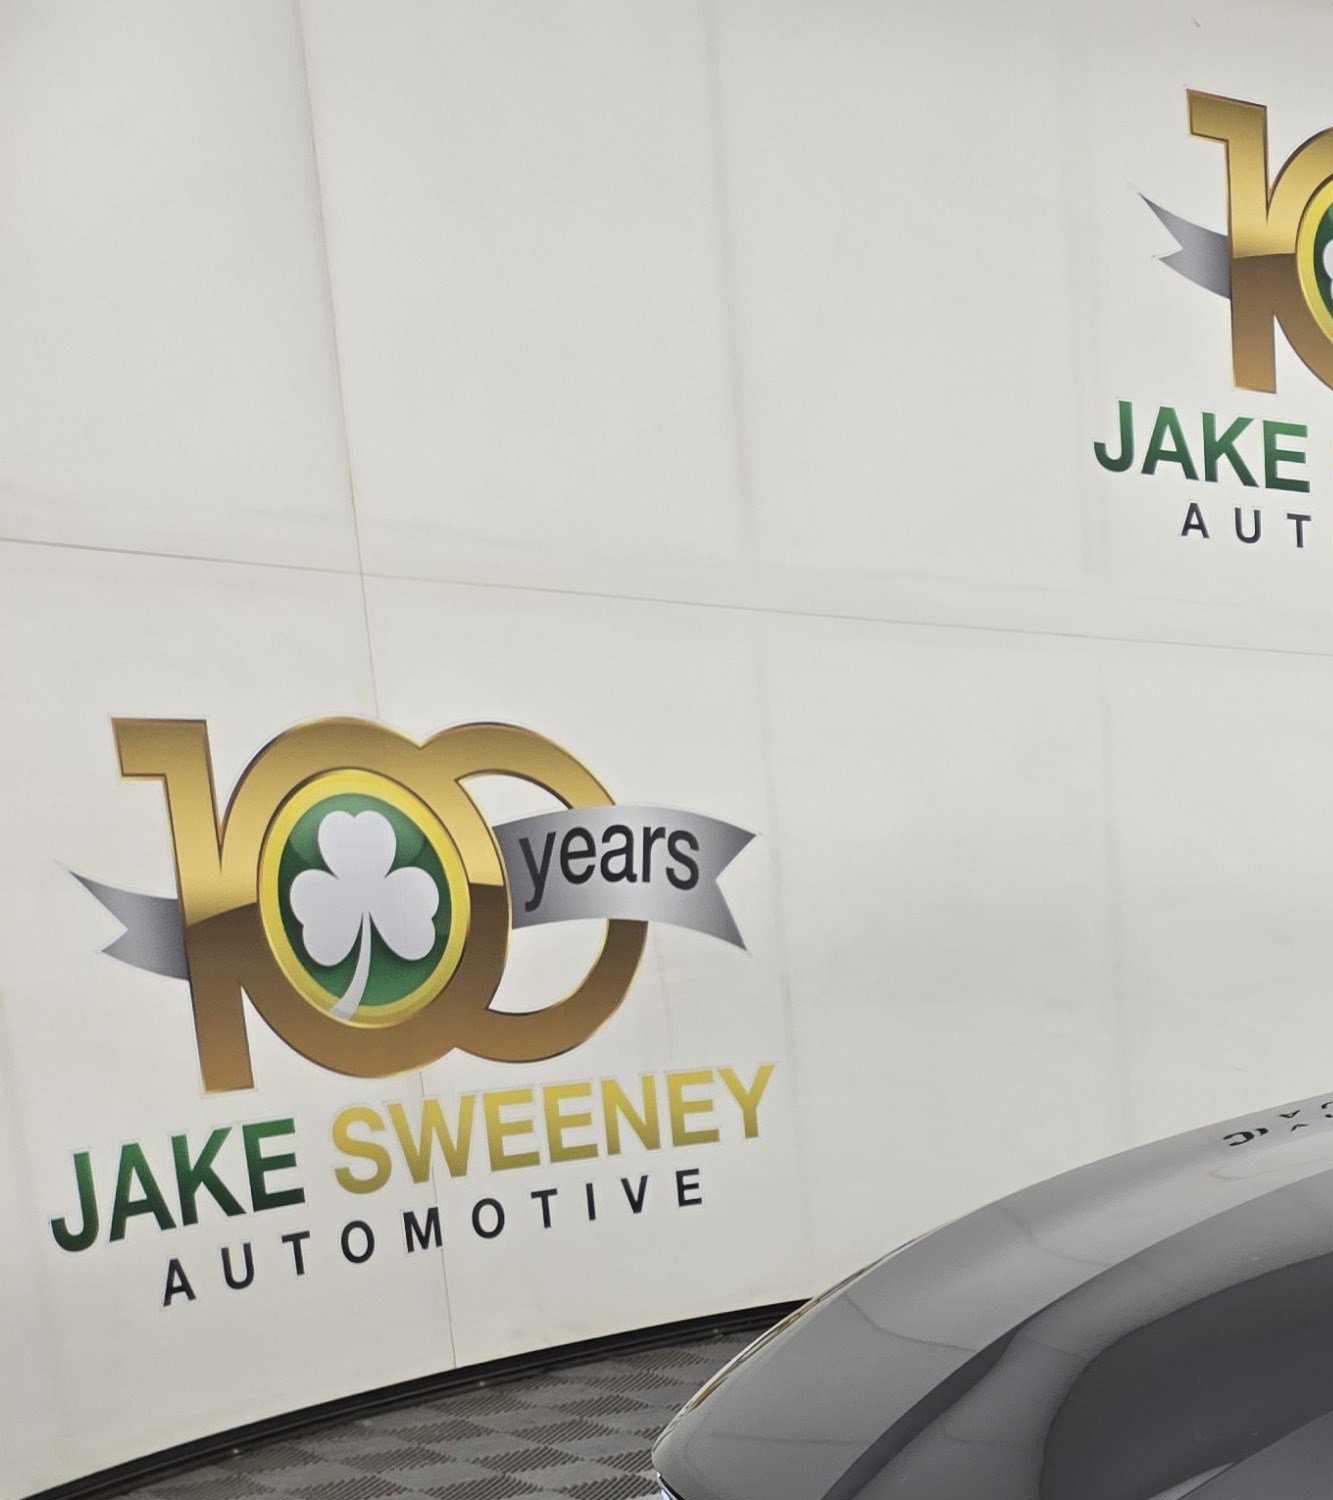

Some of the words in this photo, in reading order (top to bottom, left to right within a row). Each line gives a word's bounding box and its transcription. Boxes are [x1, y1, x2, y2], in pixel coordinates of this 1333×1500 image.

[1093, 400, 1310, 492] JAKE
[519, 824, 700, 911] years
[50, 1117, 305, 1253] JAKE
[332, 1064, 775, 1194] SWEENEY
[162, 1168, 701, 1308] AUTOMOTIVE
